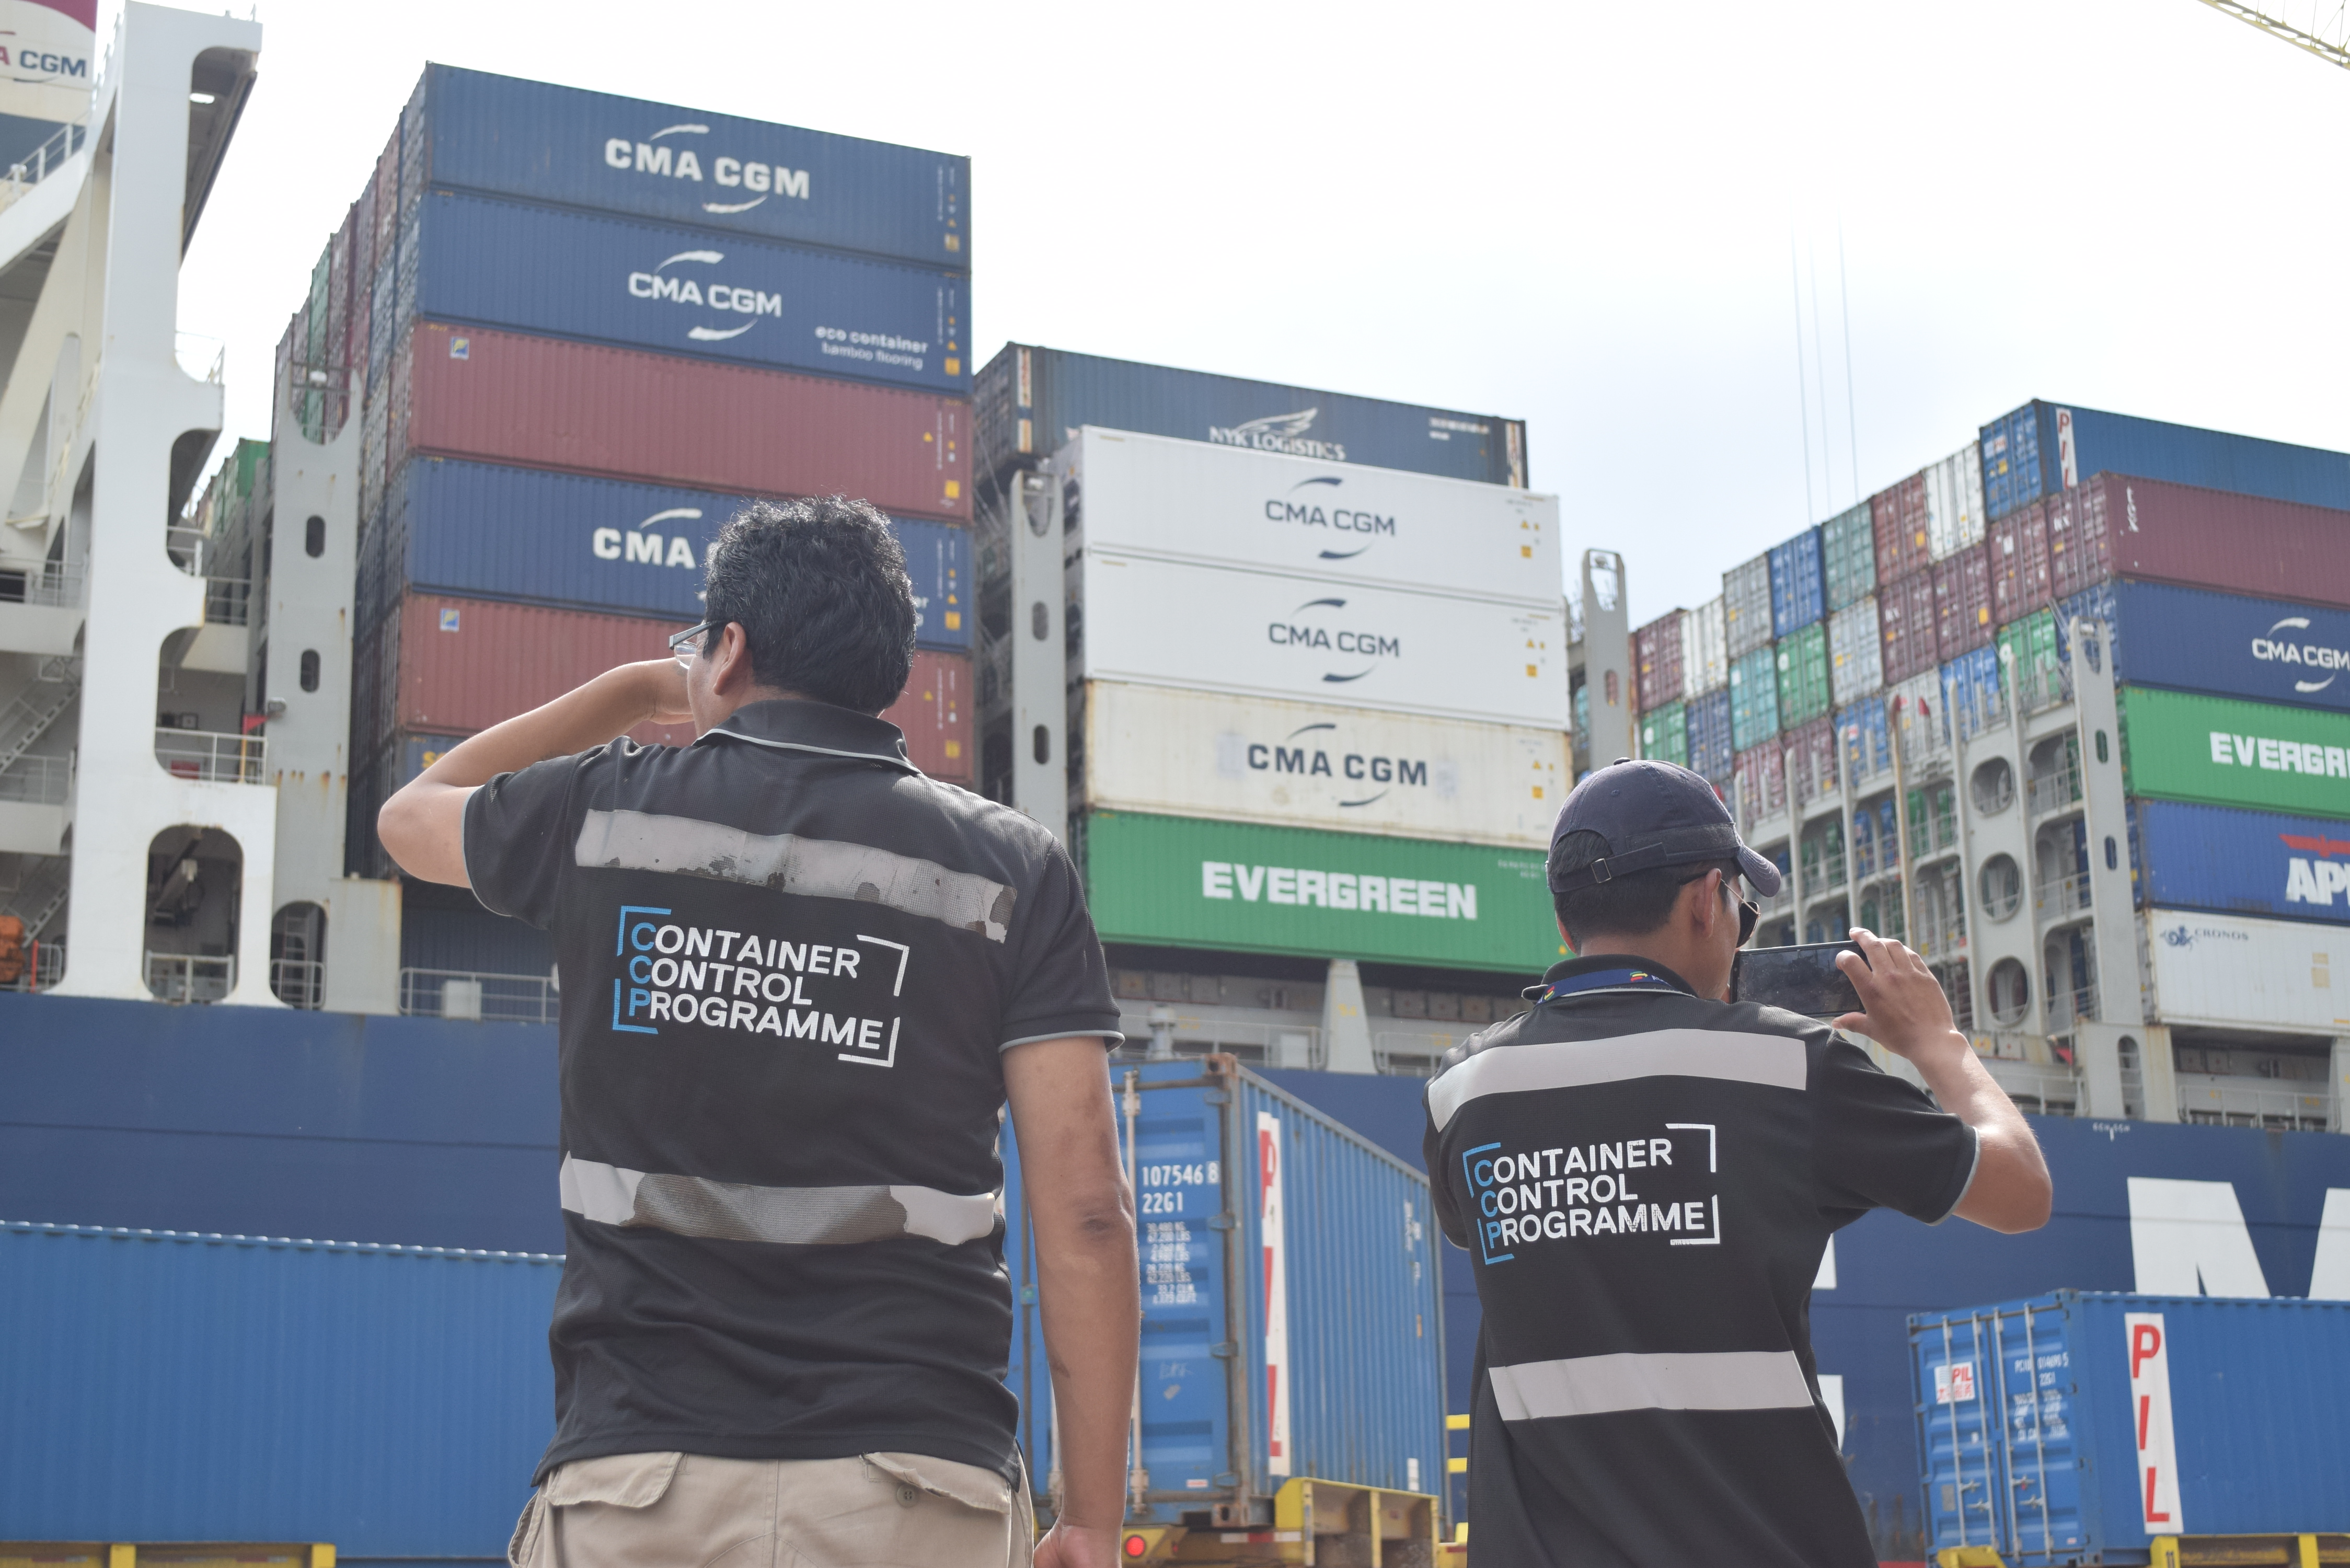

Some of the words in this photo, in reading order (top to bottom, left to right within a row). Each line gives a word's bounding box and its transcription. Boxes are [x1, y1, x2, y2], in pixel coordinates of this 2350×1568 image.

[20, 50, 86, 77] CGM
[605, 138, 702, 182] CMA
[714, 157, 810, 200] CGM
[628, 271, 704, 306] CMA
[708, 284, 782, 318] CGM
[815, 326, 847, 342] eco
[849, 329, 928, 354] container
[821, 341, 873, 362] bamboo
[874, 350, 923, 371] flooring
[1209, 425, 1249, 448] NYK
[1254, 433, 1346, 462] LOGISTICS
[1265, 500, 1327, 528] CMA
[1333, 509, 1396, 536] CGM
[593, 527, 696, 569] CMA
[1268, 624, 1331, 651] CMA
[1337, 631, 1400, 659] CGM
[2251, 638, 2302, 665] CMA
[2303, 645, 2350, 672] CGM
[1248, 743, 1332, 778] CMA
[1343, 754, 1428, 787] CGM
[2209, 731, 2350, 779] EVERGR
[1202, 860, 1477, 920] EVERGREEN
[631, 921, 860, 978] CONTAINER
[629, 955, 812, 1006] CONTROL
[628, 988, 883, 1050] PROGRAMME
[1142, 1164, 1204, 1187] 107546
[1208, 1161, 1219, 1184] 8
[1474, 1138, 1673, 1187] CONTAINER
[1143, 1191, 1183, 1214] 22G1
[1480, 1173, 1638, 1217] CONTROL
[1486, 1202, 1705, 1249] PROGRAMME
[1951, 1366, 1973, 1383] PIL
[2132, 1324, 2170, 1523] PIL
